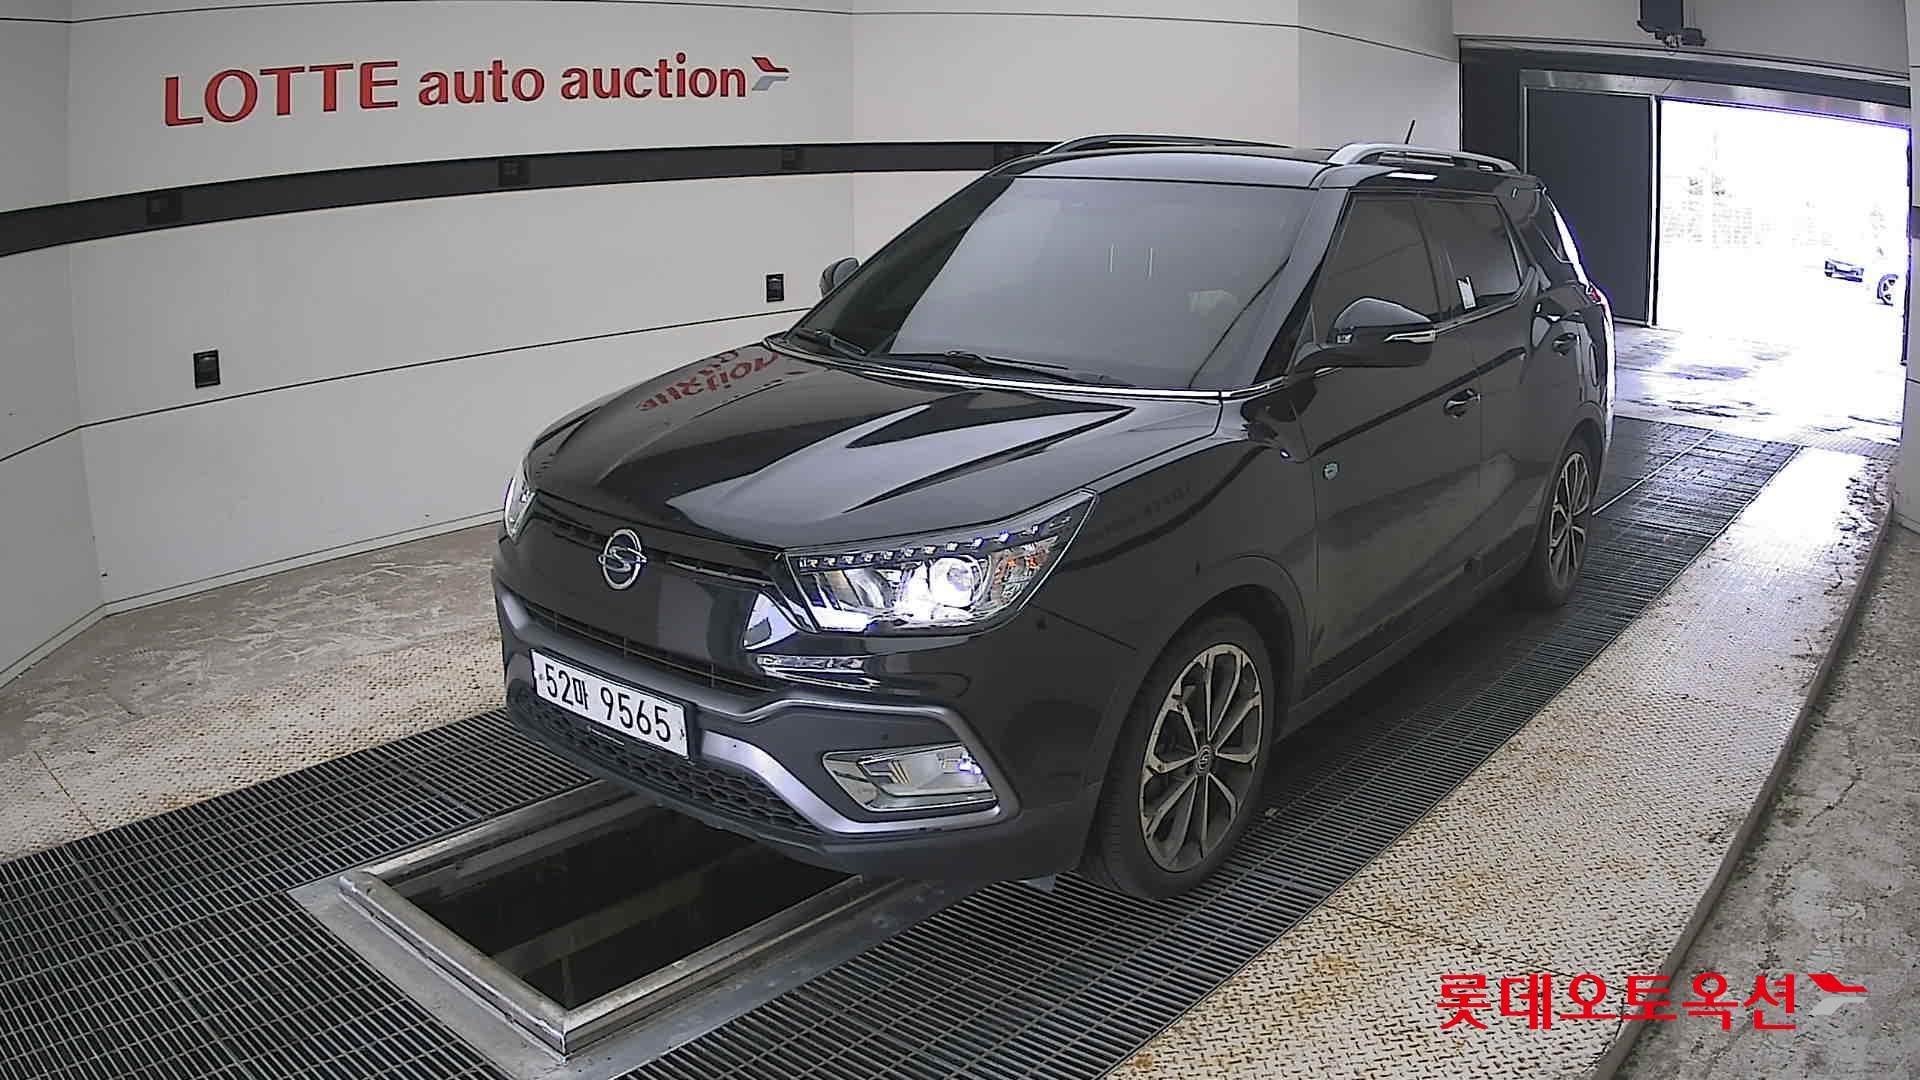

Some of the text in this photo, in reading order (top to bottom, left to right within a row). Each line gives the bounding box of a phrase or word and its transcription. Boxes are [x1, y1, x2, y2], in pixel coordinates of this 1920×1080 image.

[166, 53, 746, 126] LOTTE auto auction
[545, 664, 671, 742] 52마 9565
